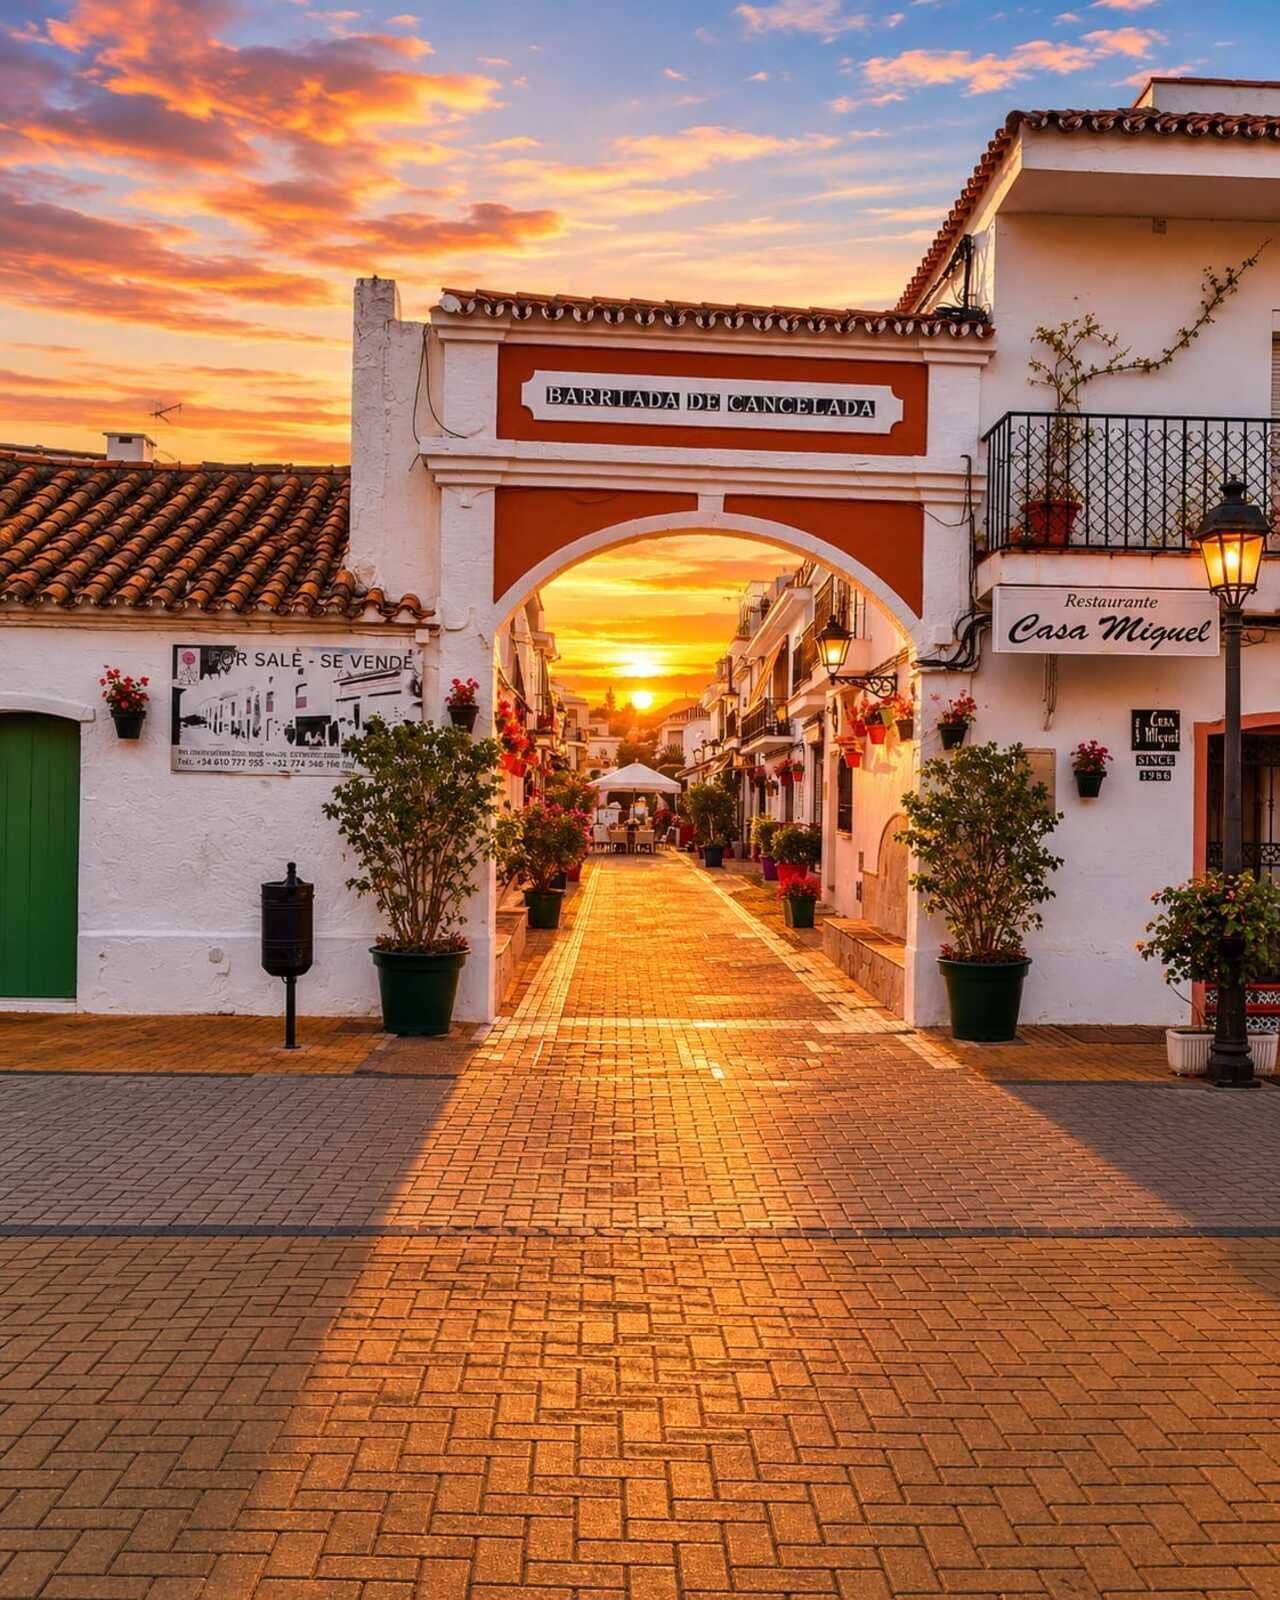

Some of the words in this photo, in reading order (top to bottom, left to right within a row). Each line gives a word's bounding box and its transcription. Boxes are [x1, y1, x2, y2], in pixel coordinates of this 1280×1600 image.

[549, 387, 679, 409] BARRIADA
[689, 393, 720, 411] DE
[728, 395, 874, 417] CANCELADA
[1064, 593, 1159, 609] Restaurante
[1008, 613, 1089, 644] Casa
[1098, 615, 1212, 650] Miguel
[254, 652, 303, 668] SALE
[320, 654, 344, 669] SE
[350, 655, 414, 670] VENDE
[1137, 755, 1174, 766] SINCE
[1142, 771, 1170, 781] 1986
